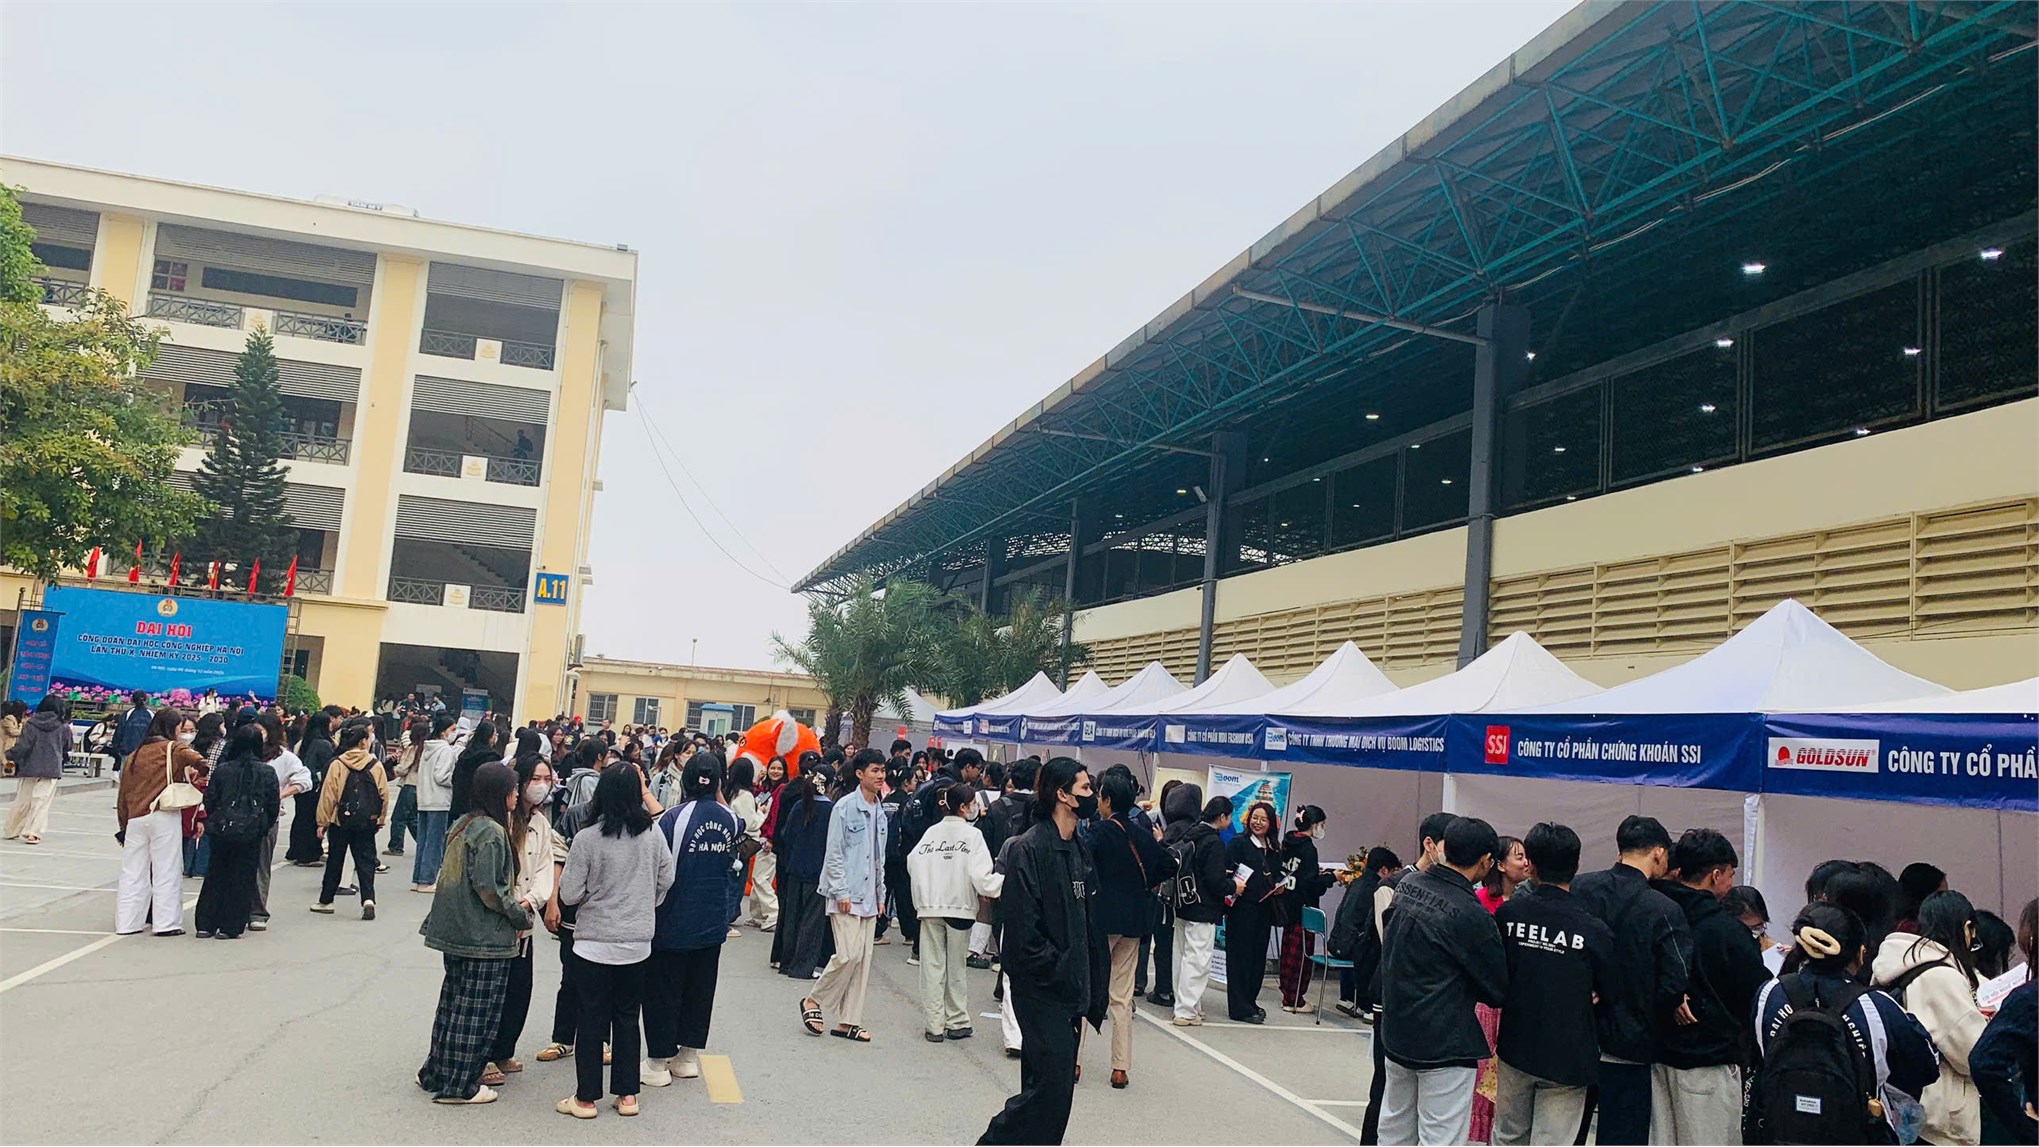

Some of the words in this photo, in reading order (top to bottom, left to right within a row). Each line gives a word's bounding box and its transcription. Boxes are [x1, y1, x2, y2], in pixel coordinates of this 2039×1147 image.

[537, 577, 566, 600] A.11
[77, 632, 100, 643] CÔNG
[136, 621, 163, 637] ĐẠI
[166, 623, 193, 640] HỘI
[181, 652, 201, 662] 2025
[209, 655, 229, 664] 2030
[1187, 729, 1197, 742] CÔNG
[1202, 728, 1208, 742] CỔ
[1208, 728, 1218, 743] PHẦN
[1228, 732, 1245, 744] FASHION
[1288, 730, 1302, 746] CÔNG
[1303, 734, 1310, 746] TY
[1310, 734, 1324, 747] TNHH
[1324, 733, 1349, 748] THƯƠNG
[1349, 735, 1361, 752] MẠI
[1361, 736, 1376, 752] DỊCH
[1377, 736, 1386, 753] VỤ
[1387, 737, 1408, 751] BOOM
[1409, 737, 1445, 752] LOGISTICS
[1487, 734, 1507, 755] SSI
[1517, 738, 1542, 758] CÔNG
[1544, 741, 1556, 758] TY
[1557, 735, 1571, 759] CỔ
[1571, 736, 1599, 760] PHẦN
[1601, 740, 1637, 761] CHỨNG
[1639, 740, 1678, 763] KHOÁN
[1681, 745, 1701, 764] SSI
[1796, 747, 1871, 767] GOLDSUN
[1887, 746, 1934, 774] CÔNG
[1940, 751, 1961, 775] TY
[1966, 744, 1993, 777] CỔ
[705, 820, 722, 831] CÔNG
[698, 841, 709, 852] HÀ
[711, 841, 726, 853] NỘI
[935, 840, 955, 852] Last
[1395, 881, 1462, 919] ESSENTIALS
[1506, 921, 1585, 950] TEELAB
